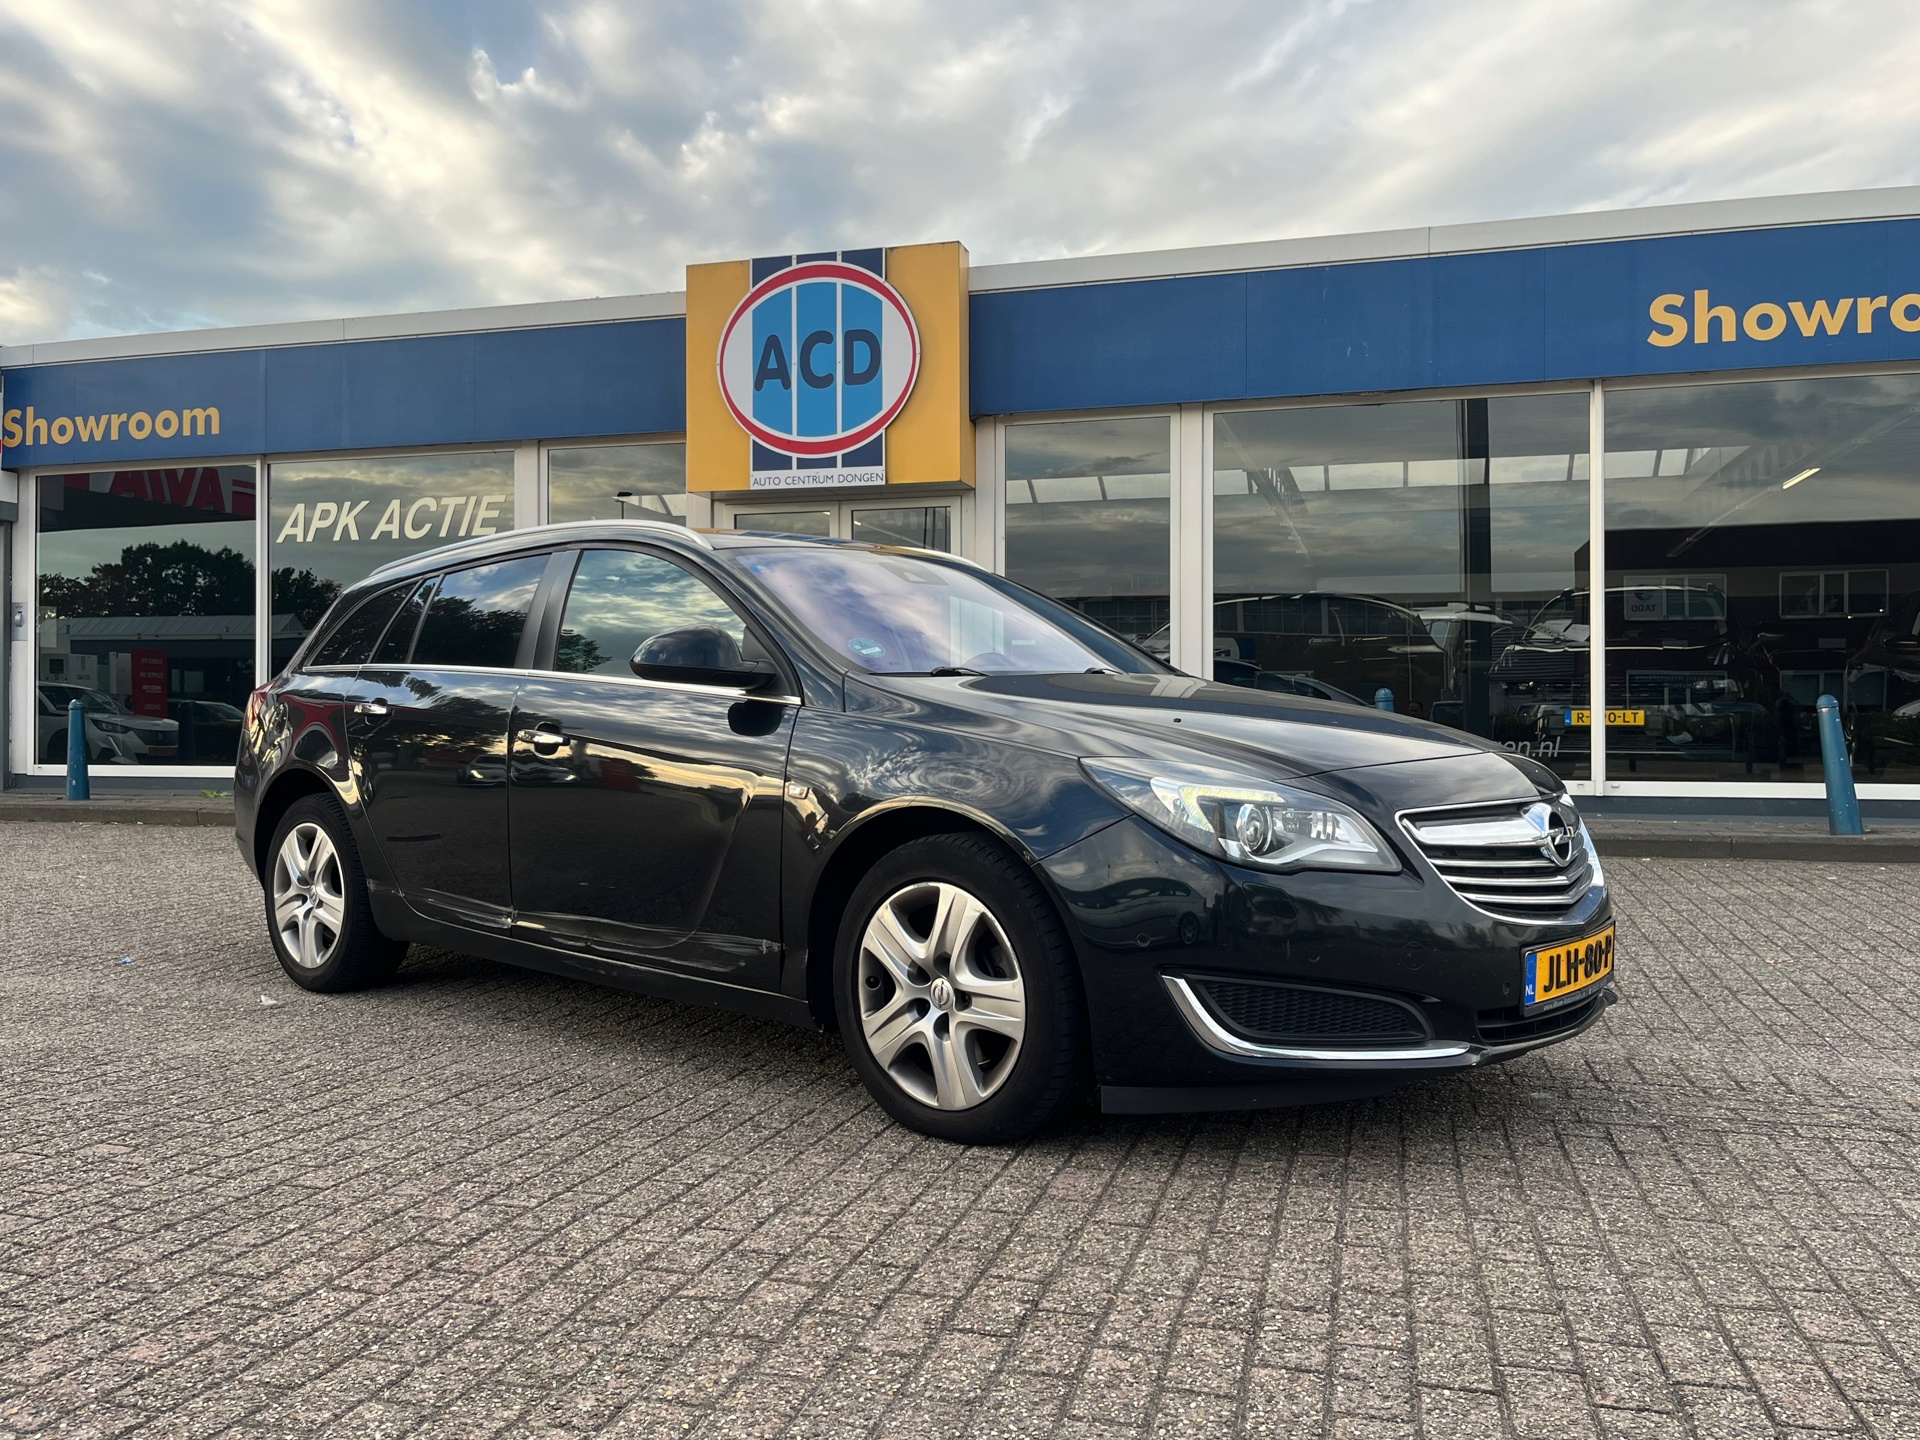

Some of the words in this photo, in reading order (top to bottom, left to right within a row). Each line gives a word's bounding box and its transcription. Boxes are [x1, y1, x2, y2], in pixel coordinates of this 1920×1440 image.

[754, 329, 881, 391] ACD
[3, 406, 220, 448] Showroom
[752, 475, 782, 487] AUTO
[785, 473, 834, 486] CENTRUM
[837, 472, 884, 484] DONGEN
[276, 501, 370, 544] APK
[371, 494, 506, 541] ACTIE
[1543, 934, 1612, 993] JLH-80-P
[1525, 984, 1535, 997] NL
